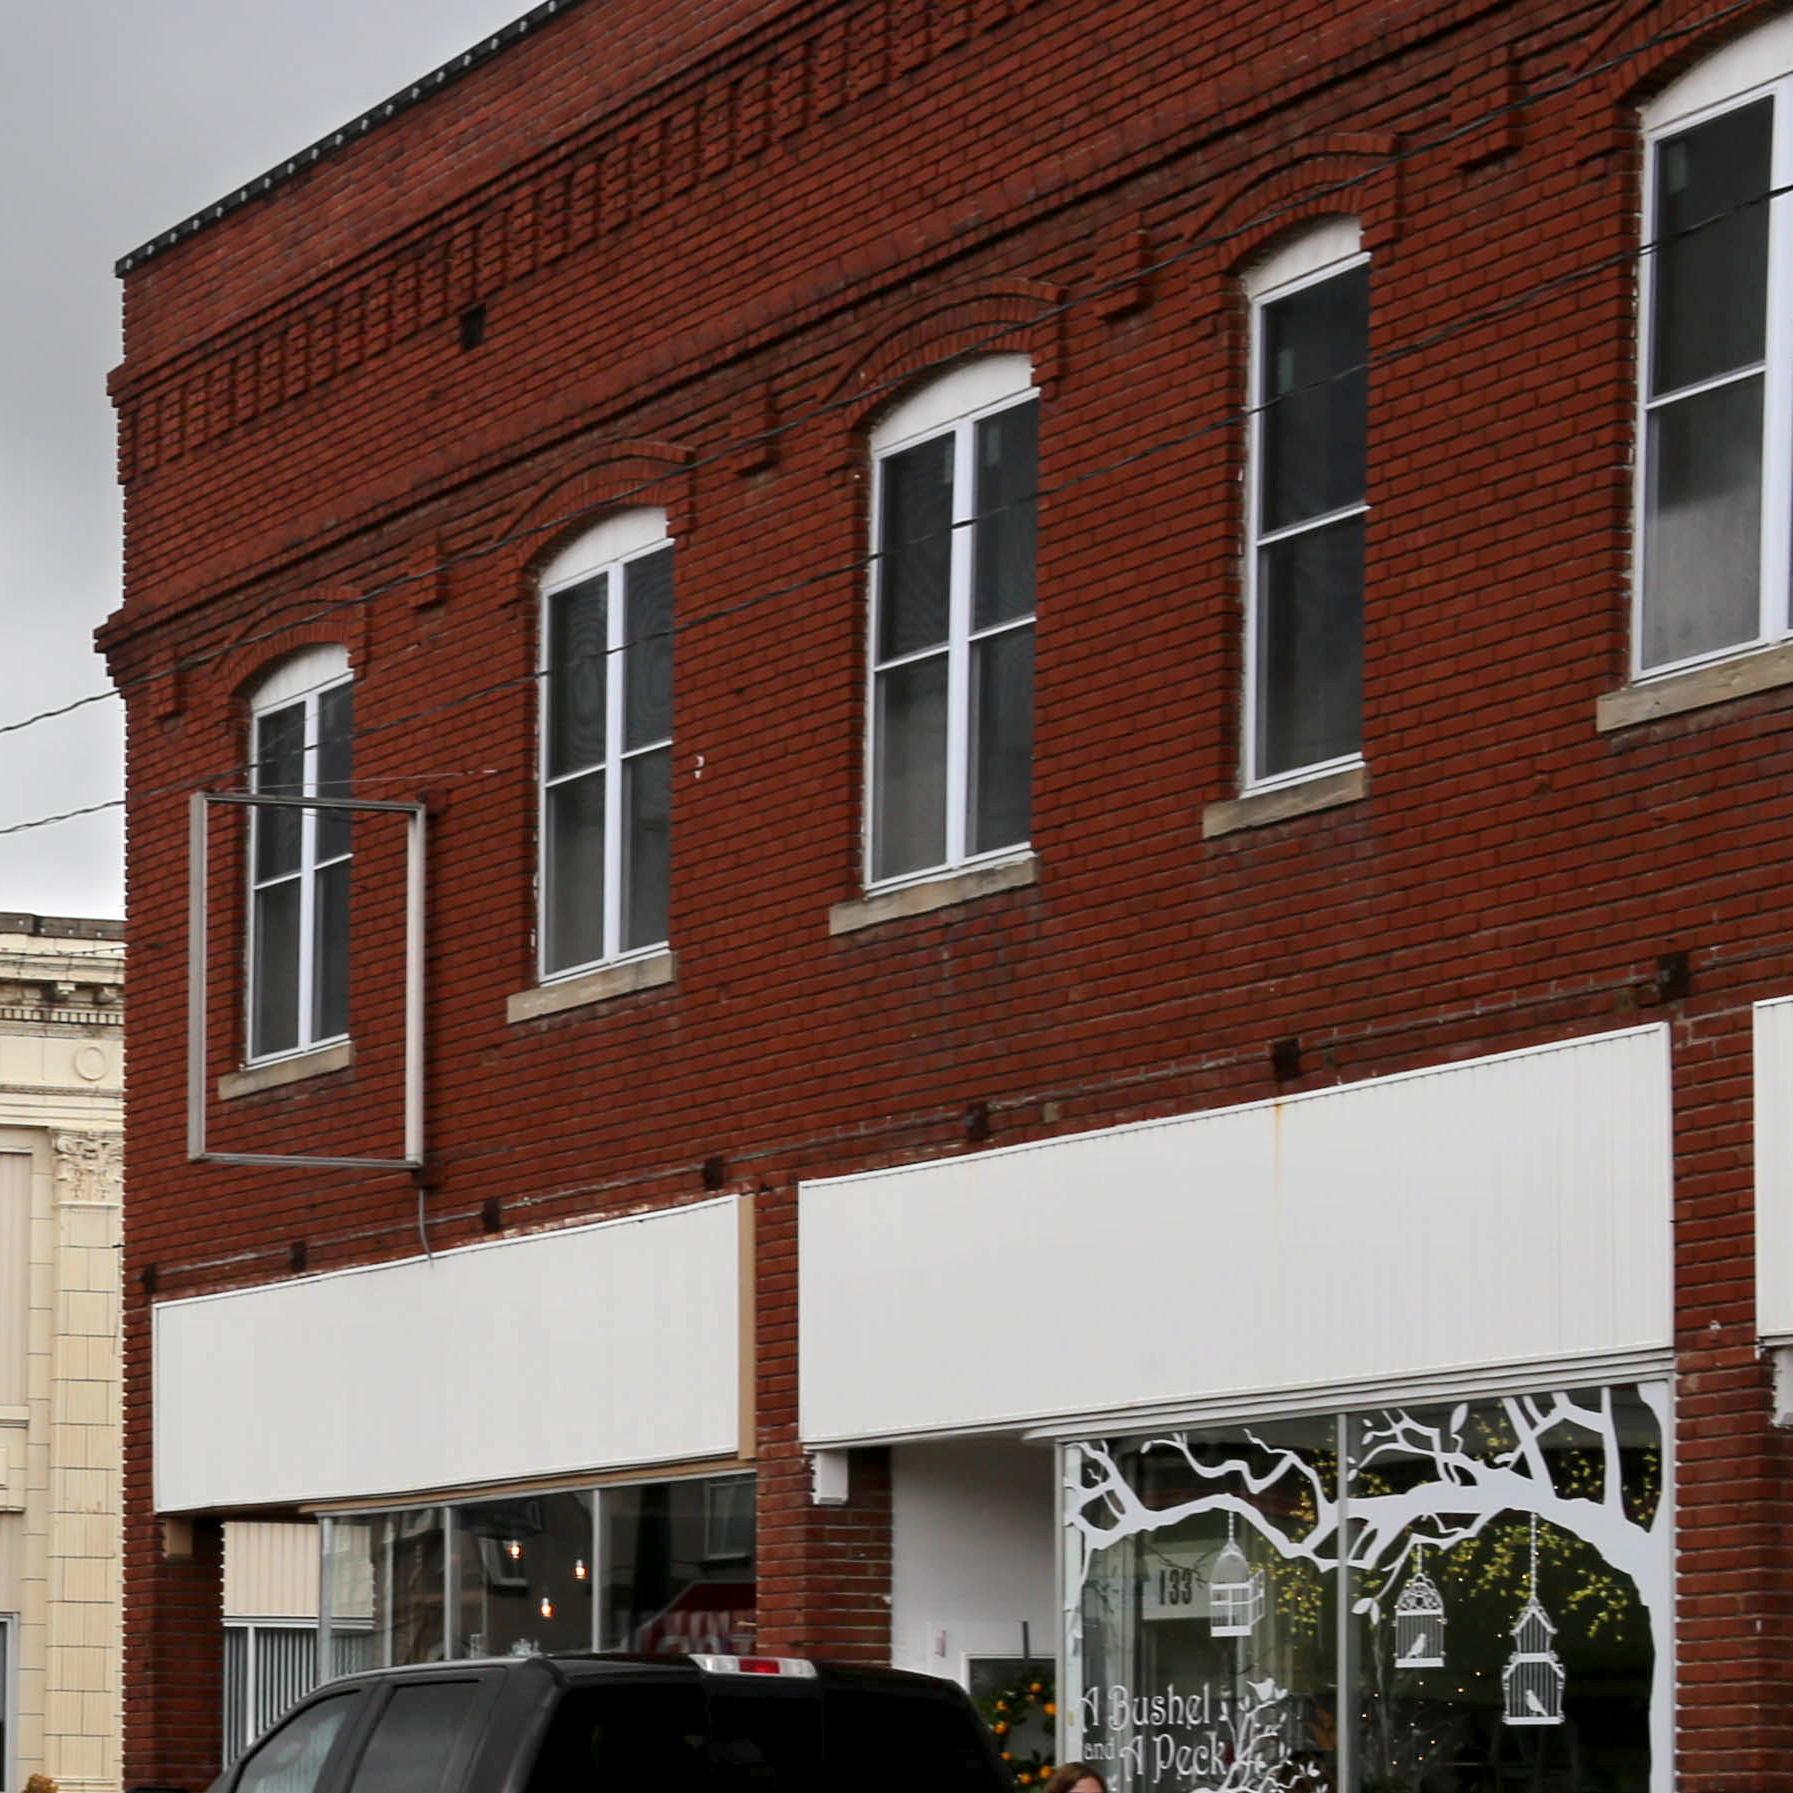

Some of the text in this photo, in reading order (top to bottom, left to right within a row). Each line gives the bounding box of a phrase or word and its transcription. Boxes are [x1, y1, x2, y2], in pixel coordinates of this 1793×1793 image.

[1159, 1568, 1192, 1605] 133
[1107, 1682, 1211, 1732] Bushel
[1084, 1730, 1228, 1784] and A Peck
